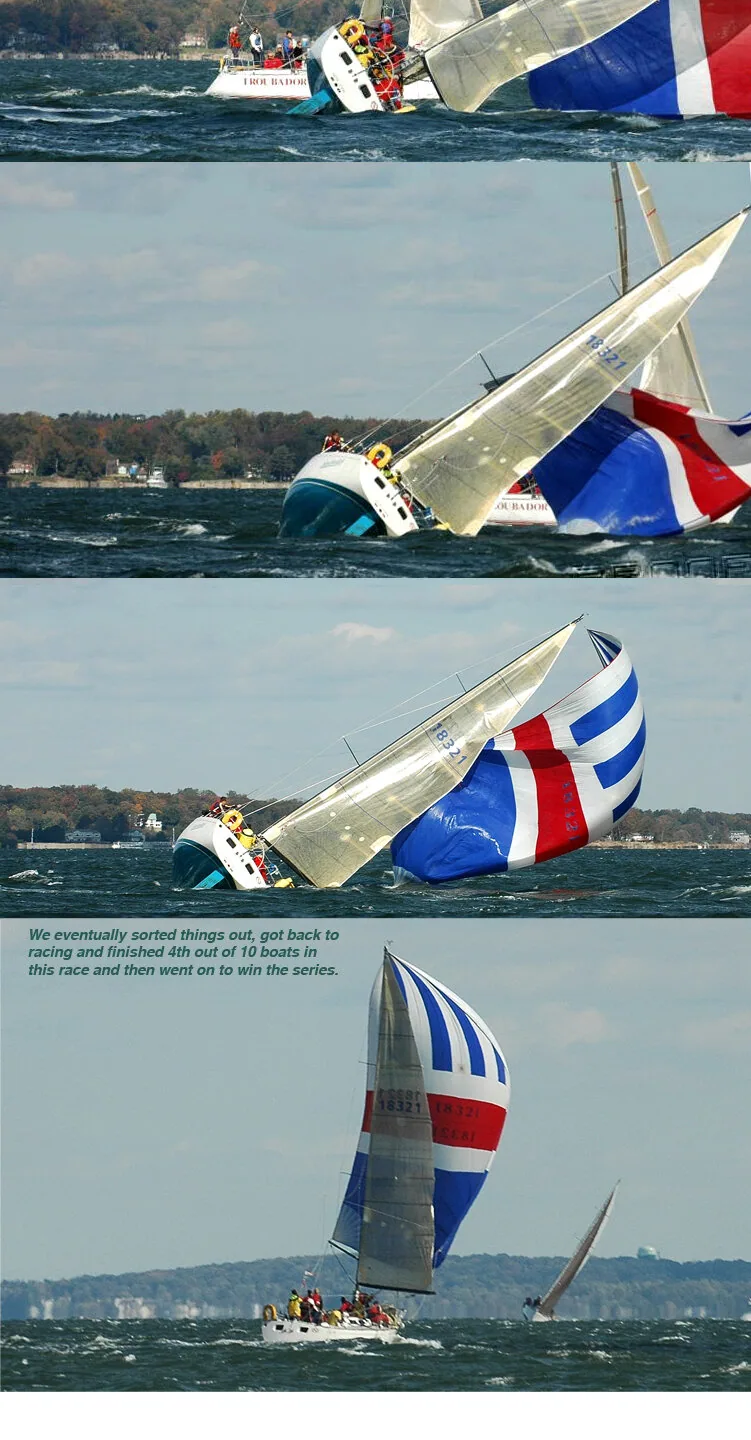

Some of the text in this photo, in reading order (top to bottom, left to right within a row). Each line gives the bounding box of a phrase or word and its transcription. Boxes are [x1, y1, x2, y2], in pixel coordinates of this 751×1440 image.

[586, 334, 627, 370] 18321
[496, 501, 548, 511] OUBADOR
[432, 722, 468, 765] 18321
[379, 1100, 421, 1113] 18321
[435, 1101, 480, 1119] 18321
